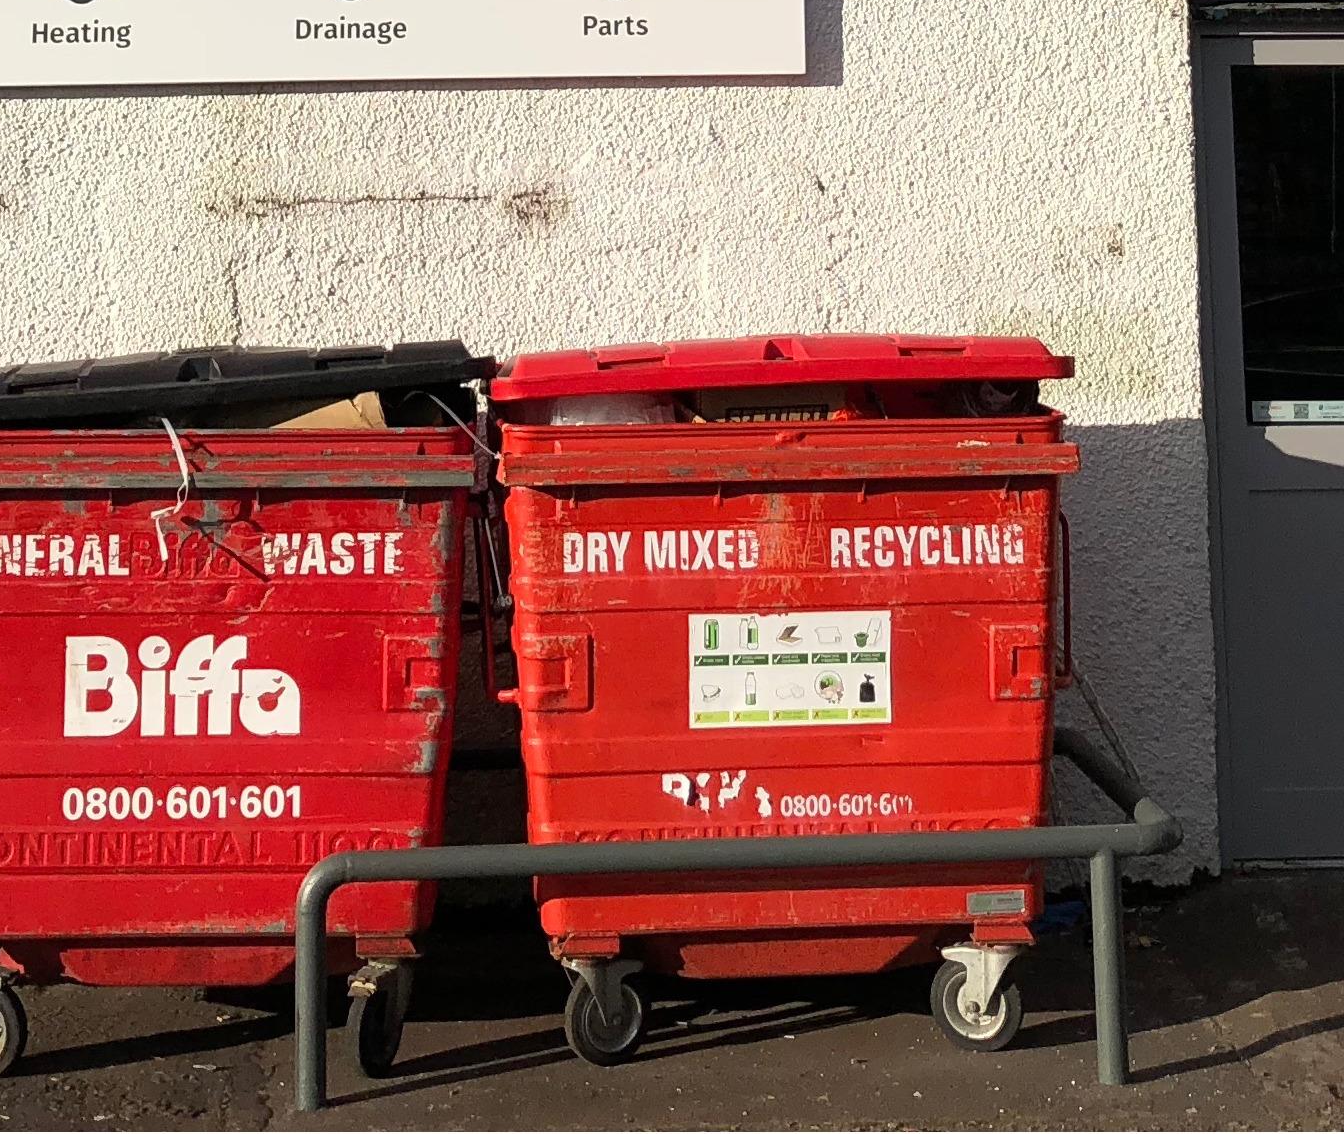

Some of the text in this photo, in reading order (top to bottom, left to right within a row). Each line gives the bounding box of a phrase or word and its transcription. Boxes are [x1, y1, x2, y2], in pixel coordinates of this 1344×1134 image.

[31, 18, 133, 49] Heating
[294, 15, 408, 45] Drainage
[582, 15, 650, 36] Parts
[261, 530, 405, 576] WASTE
[562, 523, 1025, 574] DRY MIXED RECYCLING
[63, 634, 301, 738] Biffa
